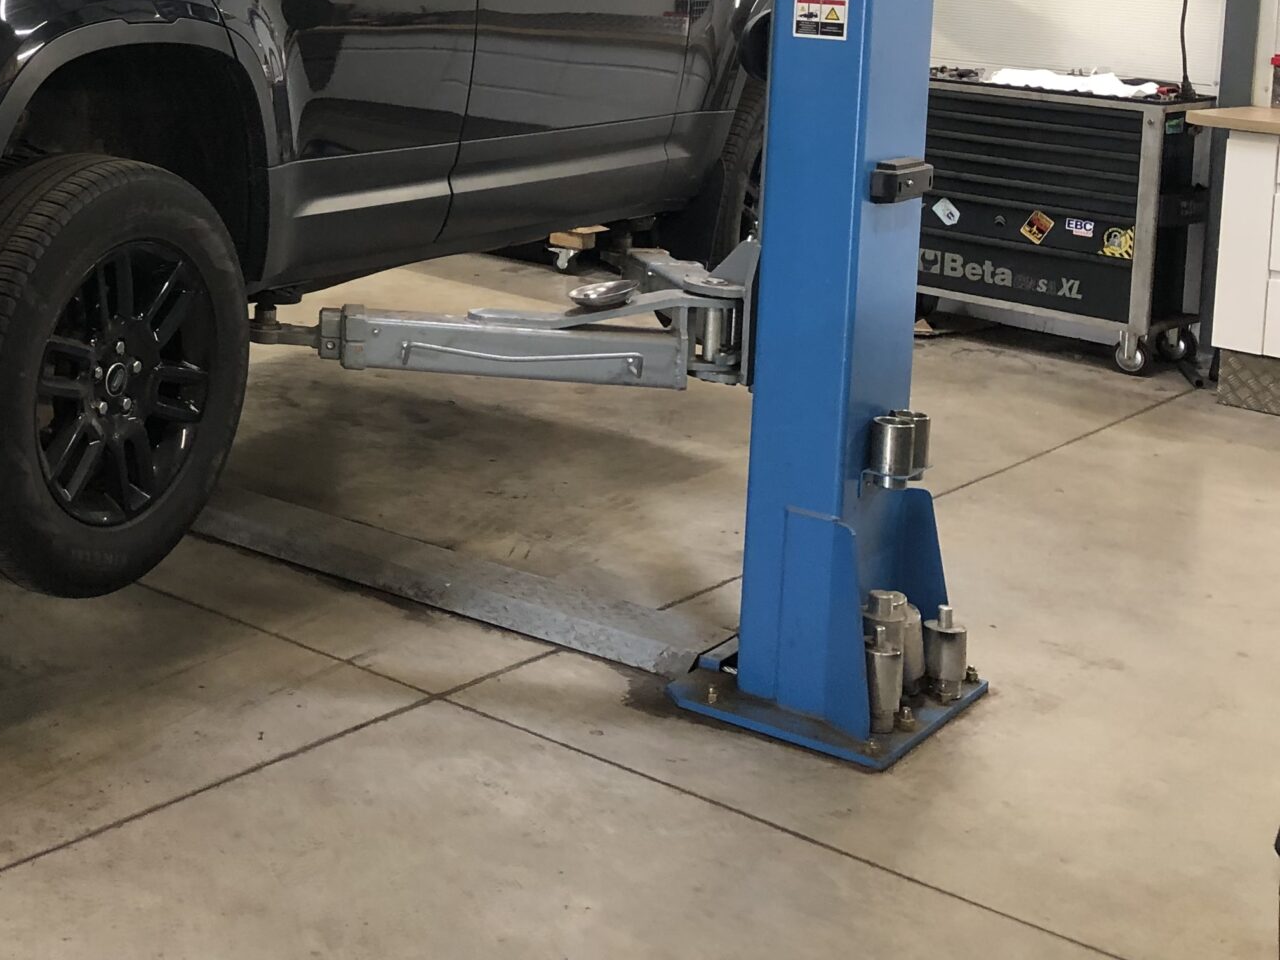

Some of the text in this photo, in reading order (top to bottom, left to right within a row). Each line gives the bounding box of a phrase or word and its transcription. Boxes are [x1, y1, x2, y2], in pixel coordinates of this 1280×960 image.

[1066, 219, 1094, 232] EBC
[943, 252, 1013, 288] Beta
[1057, 277, 1083, 300] XL
